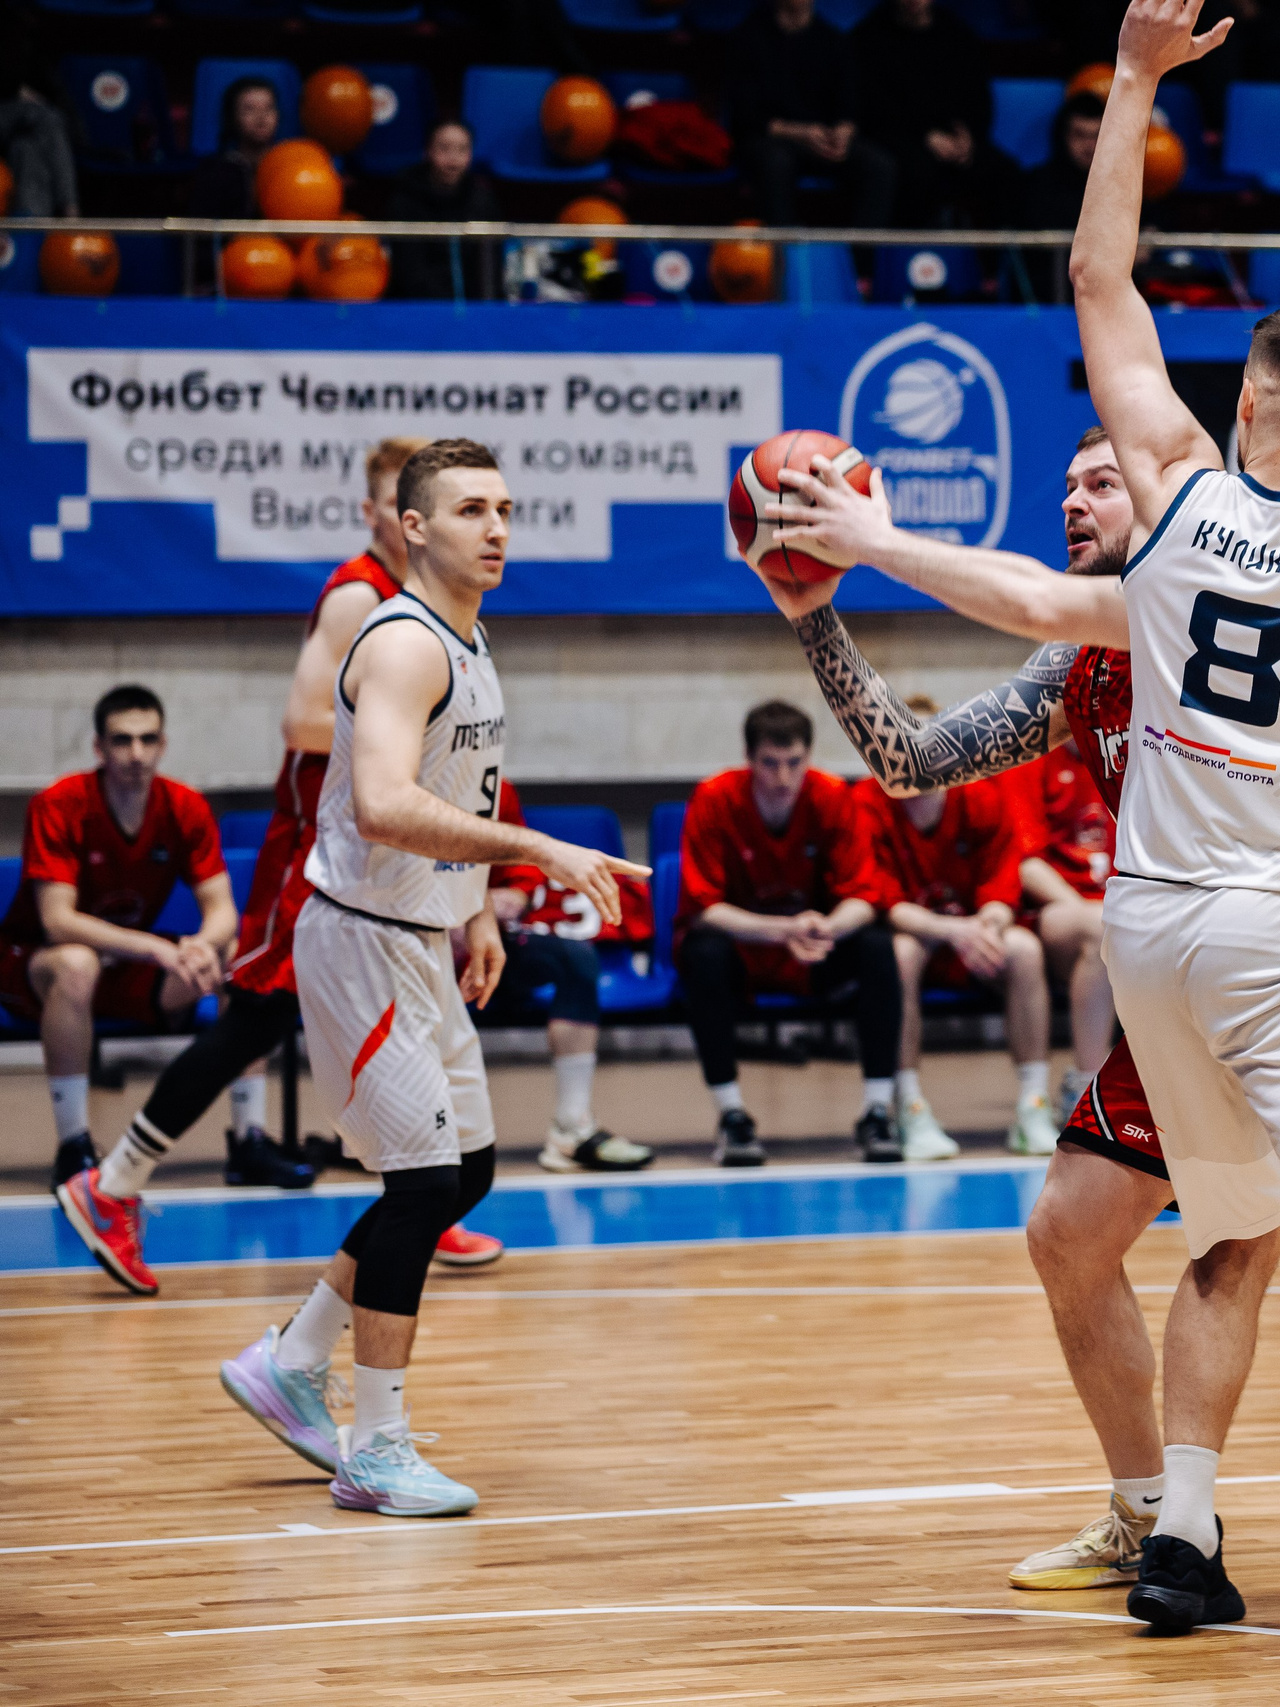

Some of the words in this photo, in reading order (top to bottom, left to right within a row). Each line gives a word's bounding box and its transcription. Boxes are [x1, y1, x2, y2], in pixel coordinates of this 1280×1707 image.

[70, 369, 264, 414] Фонбет
[280, 372, 549, 416] Чемпионат
[564, 374, 743, 417] России
[125, 437, 283, 480] среди
[521, 440, 698, 477] команд
[1142, 738, 1163, 757] ФОНД
[1164, 742, 1227, 771] ПОДДЕРЖКИ
[1227, 770, 1275, 786] СПОРТА
[1121, 1123, 1153, 1143] STK
